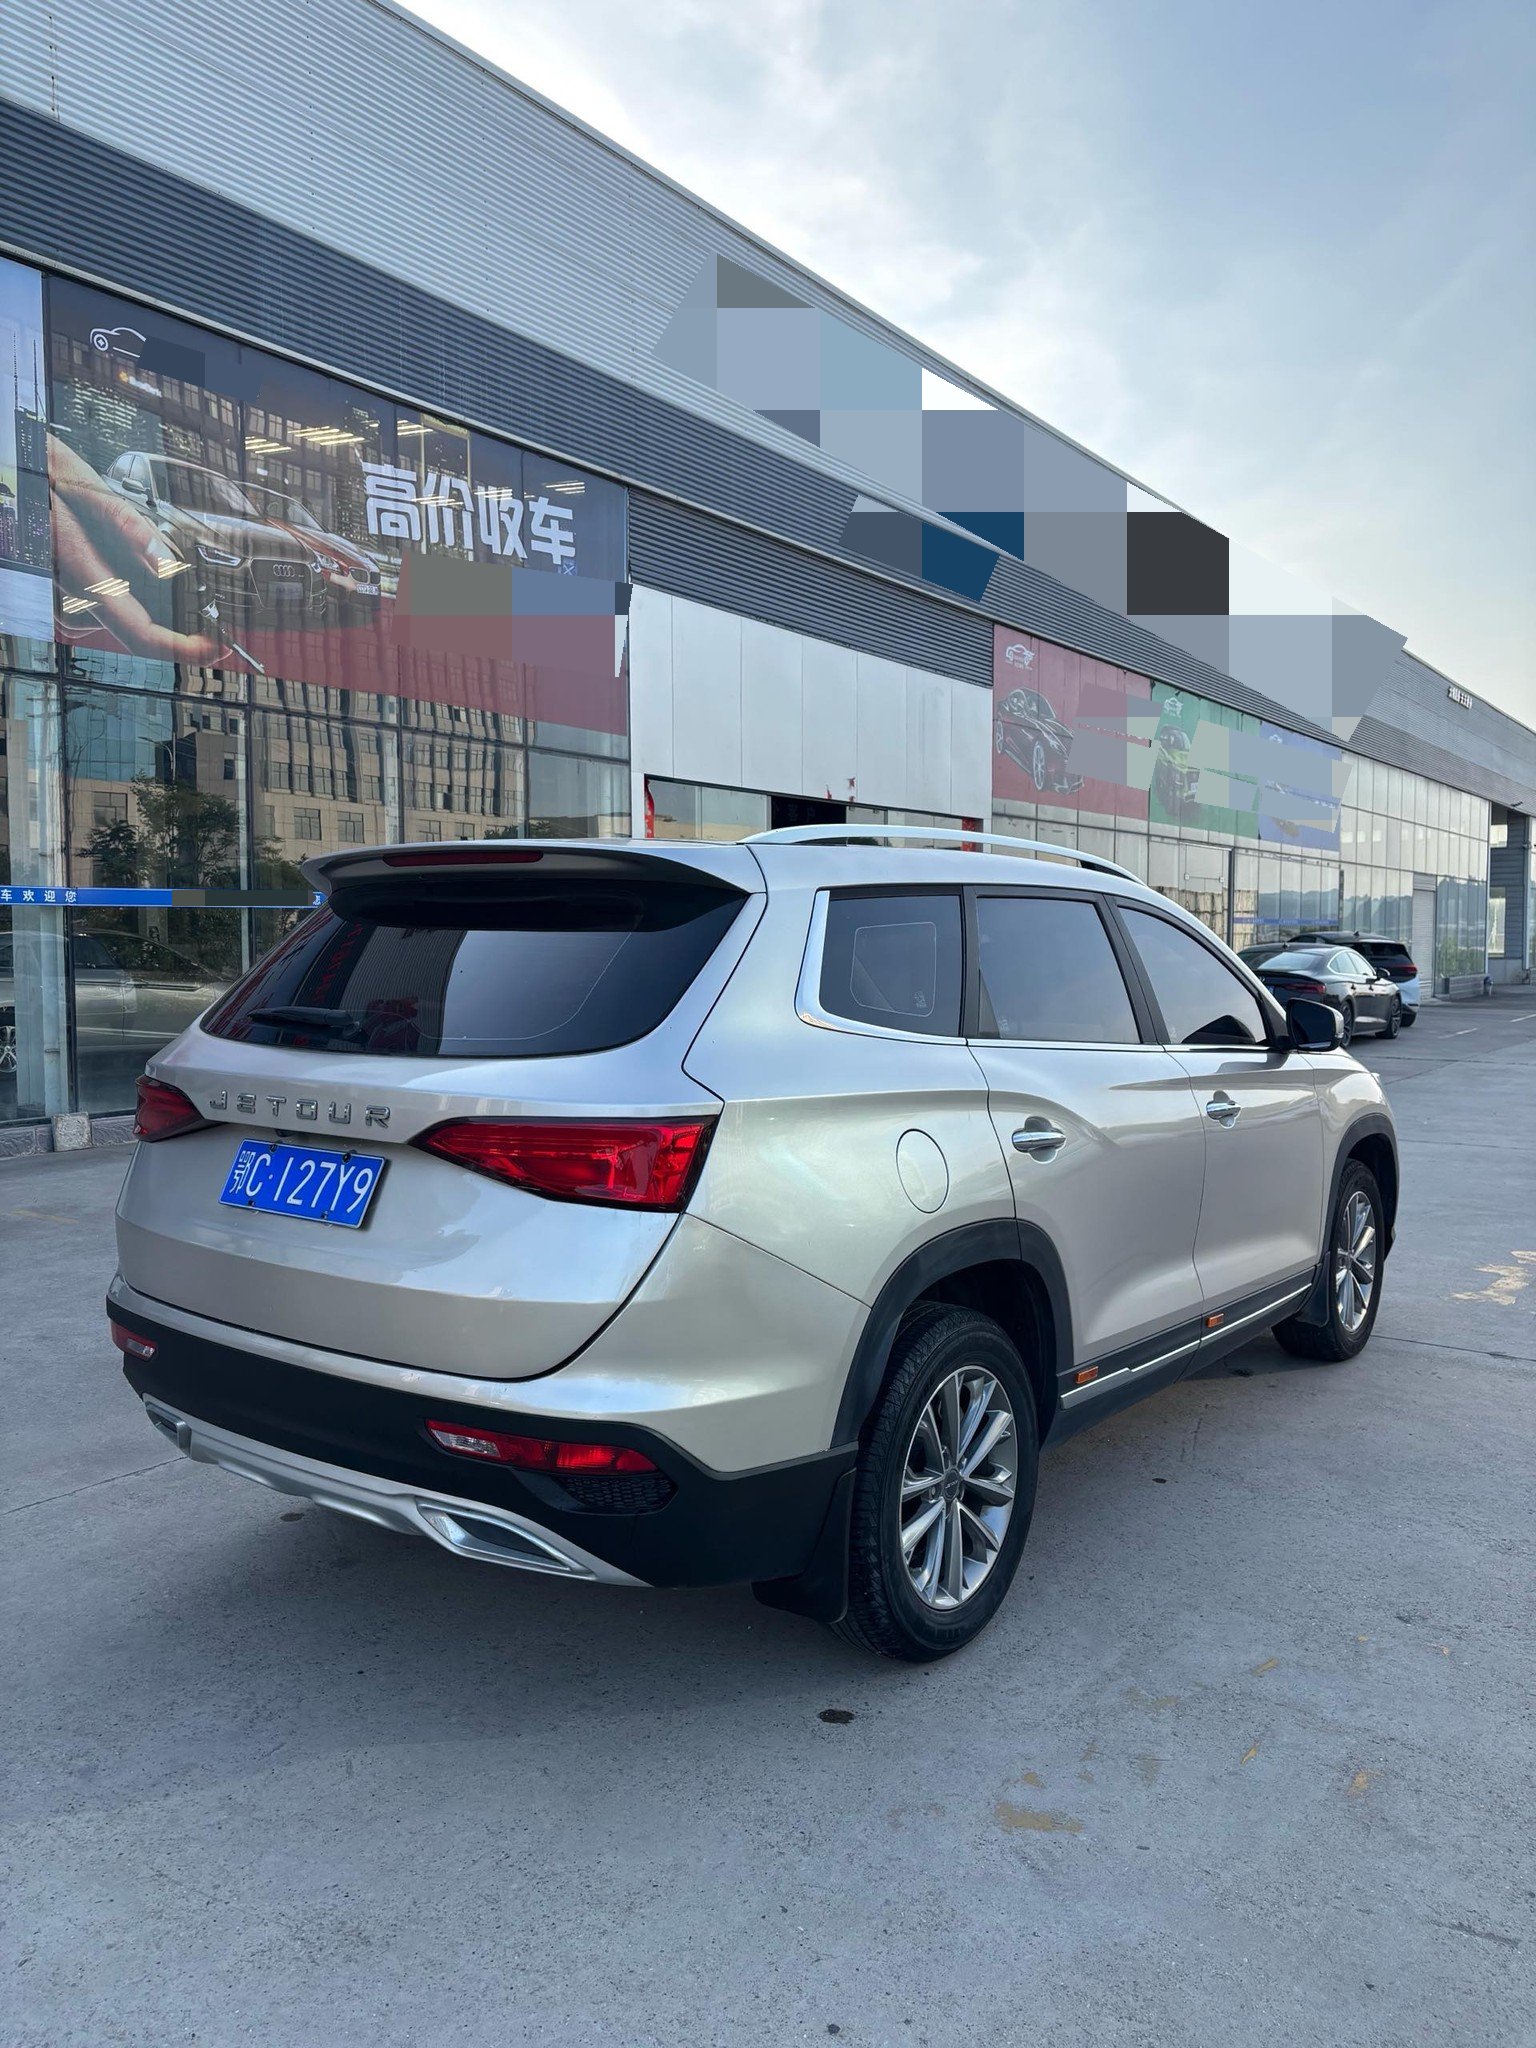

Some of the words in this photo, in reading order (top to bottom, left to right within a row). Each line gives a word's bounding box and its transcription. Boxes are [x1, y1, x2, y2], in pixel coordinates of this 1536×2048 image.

[361, 461, 577, 565] 高价收车
[0, 888, 77, 903] 车欢迎您
[209, 1090, 391, 1128] JETOUR
